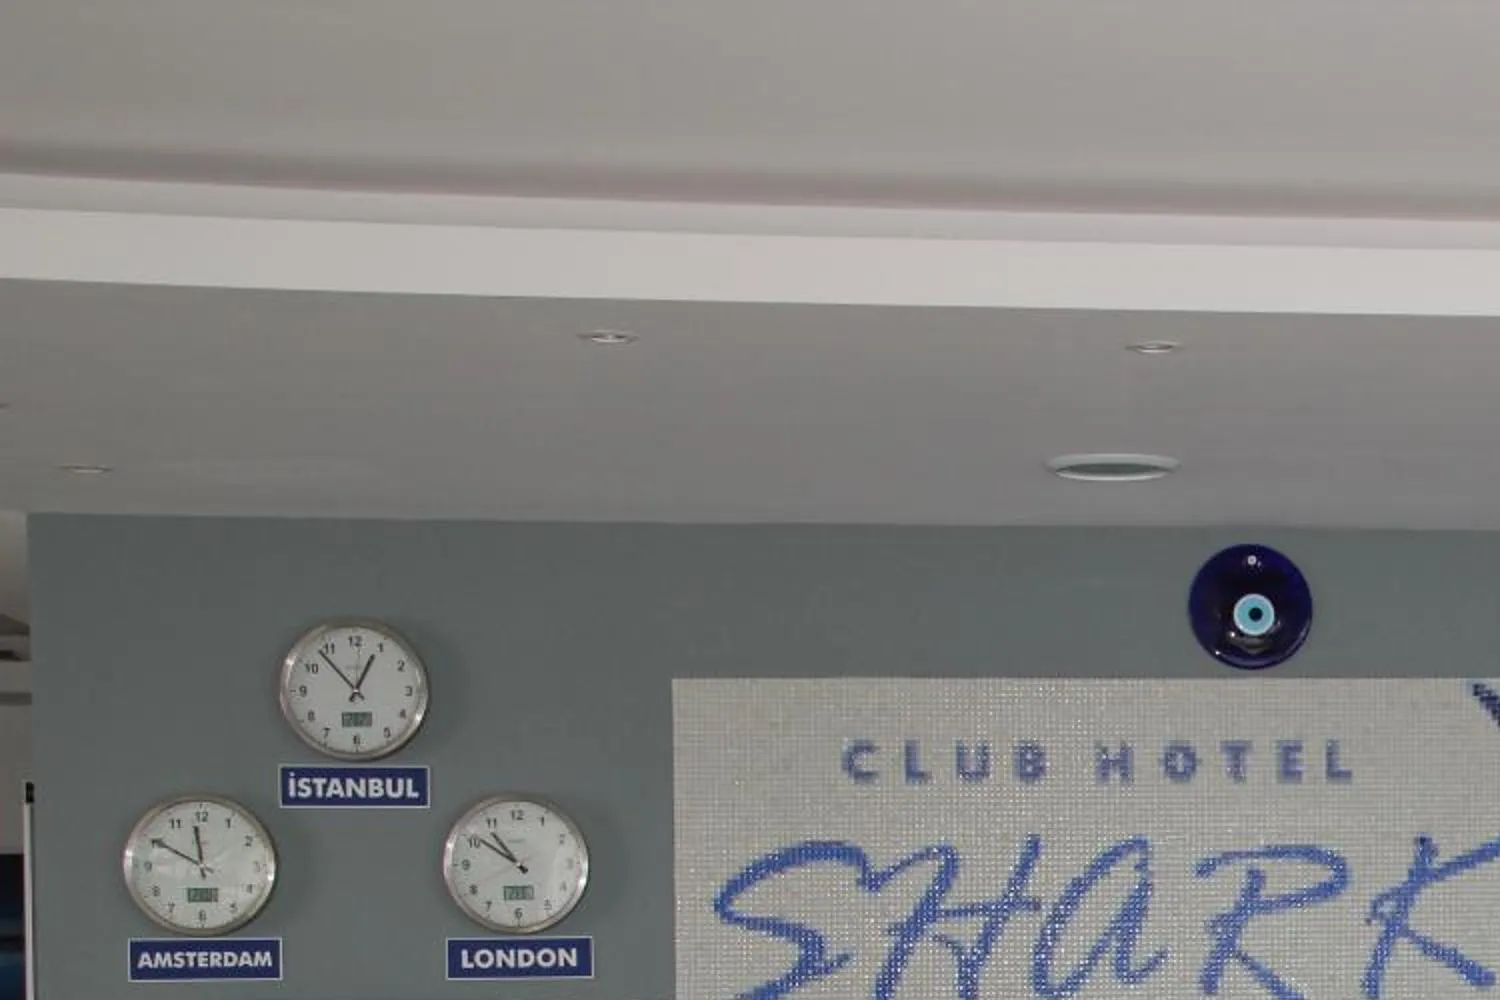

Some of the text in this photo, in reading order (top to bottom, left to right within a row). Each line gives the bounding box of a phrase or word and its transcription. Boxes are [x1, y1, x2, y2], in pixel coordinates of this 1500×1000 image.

[841, 738, 1355, 784] CLUB HOTEL
[288, 772, 419, 799] İSTANBUL
[137, 951, 273, 969] AMSTERDAM
[461, 947, 577, 969] LONDON
